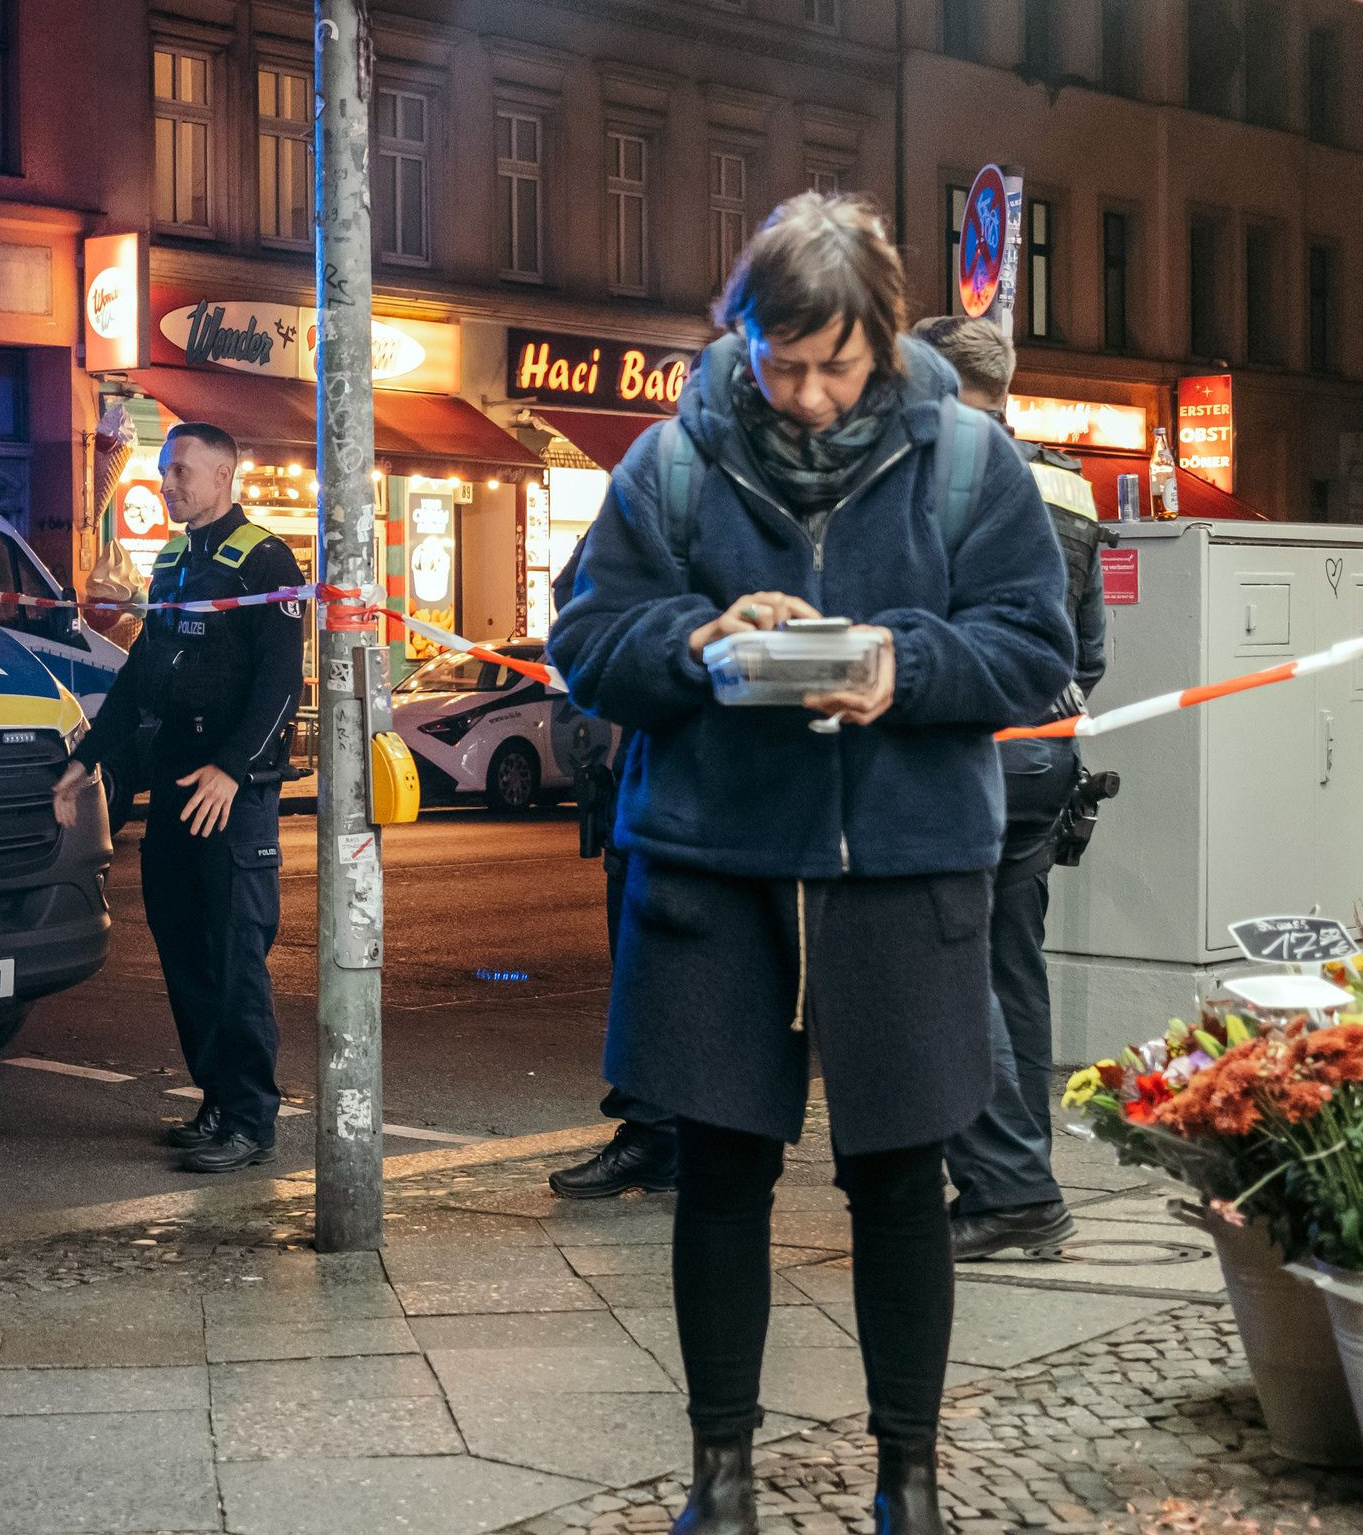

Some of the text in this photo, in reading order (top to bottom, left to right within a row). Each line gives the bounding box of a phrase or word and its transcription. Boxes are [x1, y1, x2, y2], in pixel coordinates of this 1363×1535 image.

[186, 297, 274, 366] Wonder
[520, 342, 686, 403] Haci Bab
[1179, 403, 1230, 418] ERSTER
[1179, 425, 1230, 444] OBST
[1179, 455, 1230, 469] DÖNER
[461, 485, 471, 500] 89
[177, 620, 205, 636] POLIZEI
